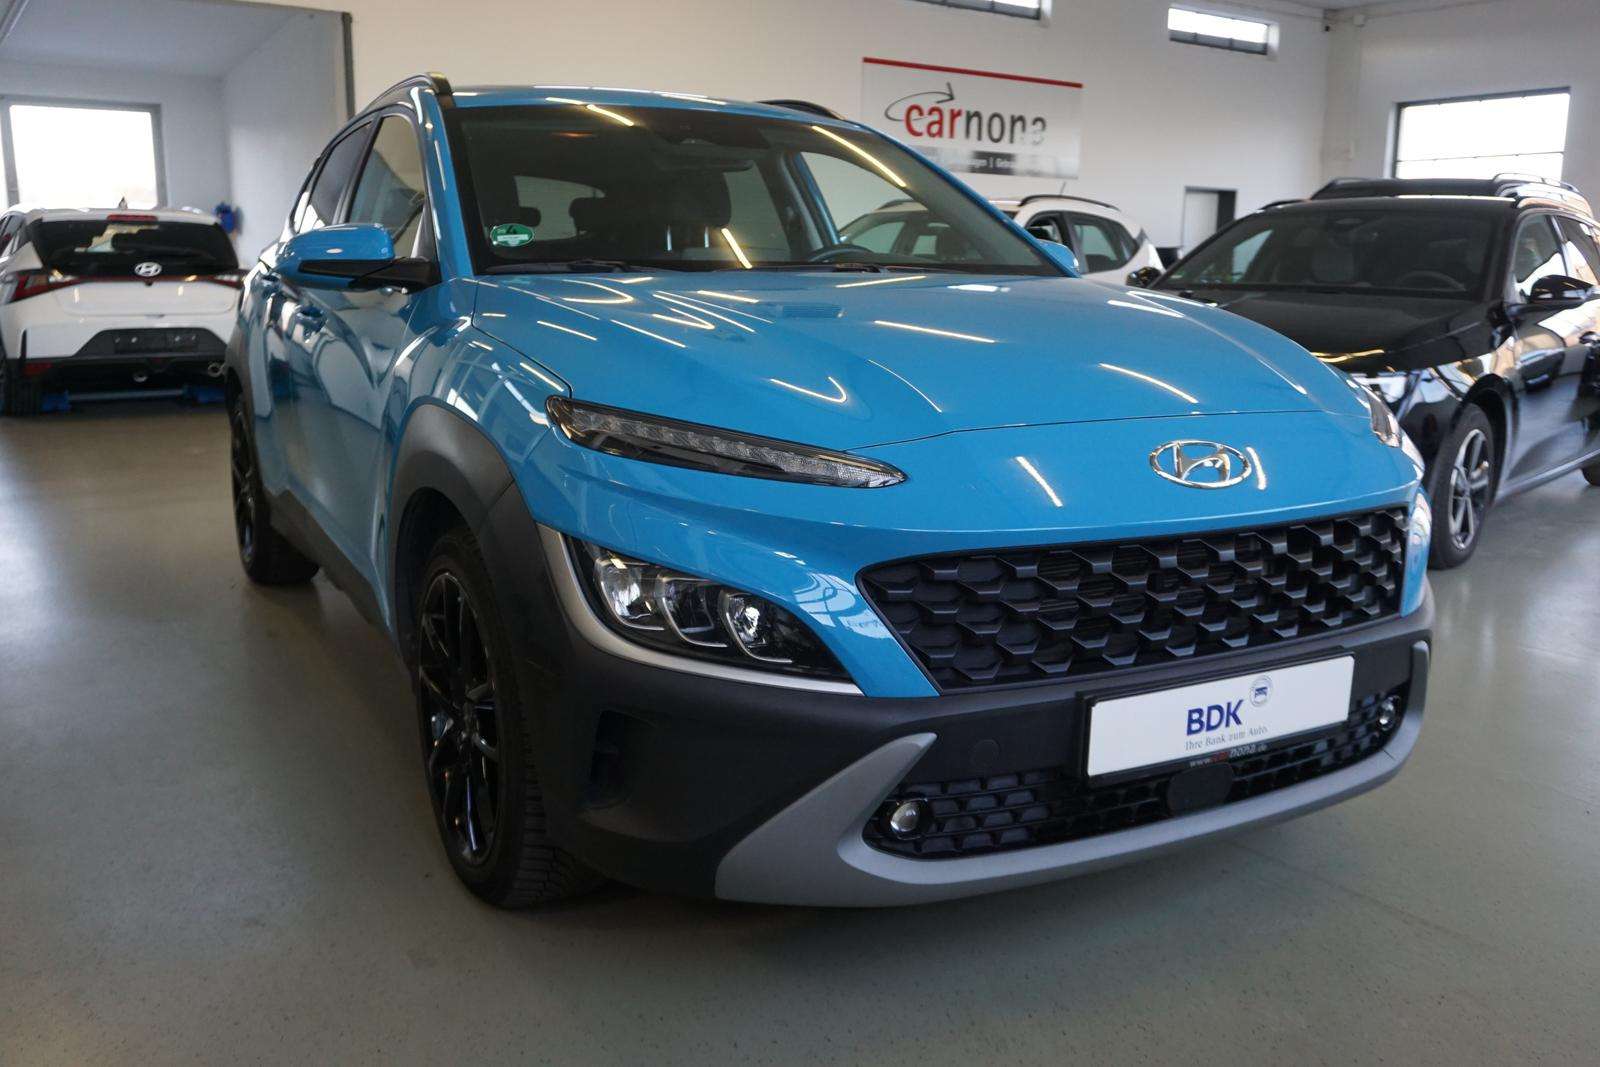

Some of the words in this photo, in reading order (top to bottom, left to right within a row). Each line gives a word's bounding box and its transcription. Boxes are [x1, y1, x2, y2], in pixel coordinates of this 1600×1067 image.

[1186, 699, 1244, 737] BDK
[1184, 740, 1203, 751] Ihre
[1205, 735, 1226, 746] Bank
[1228, 731, 1246, 742] zum
